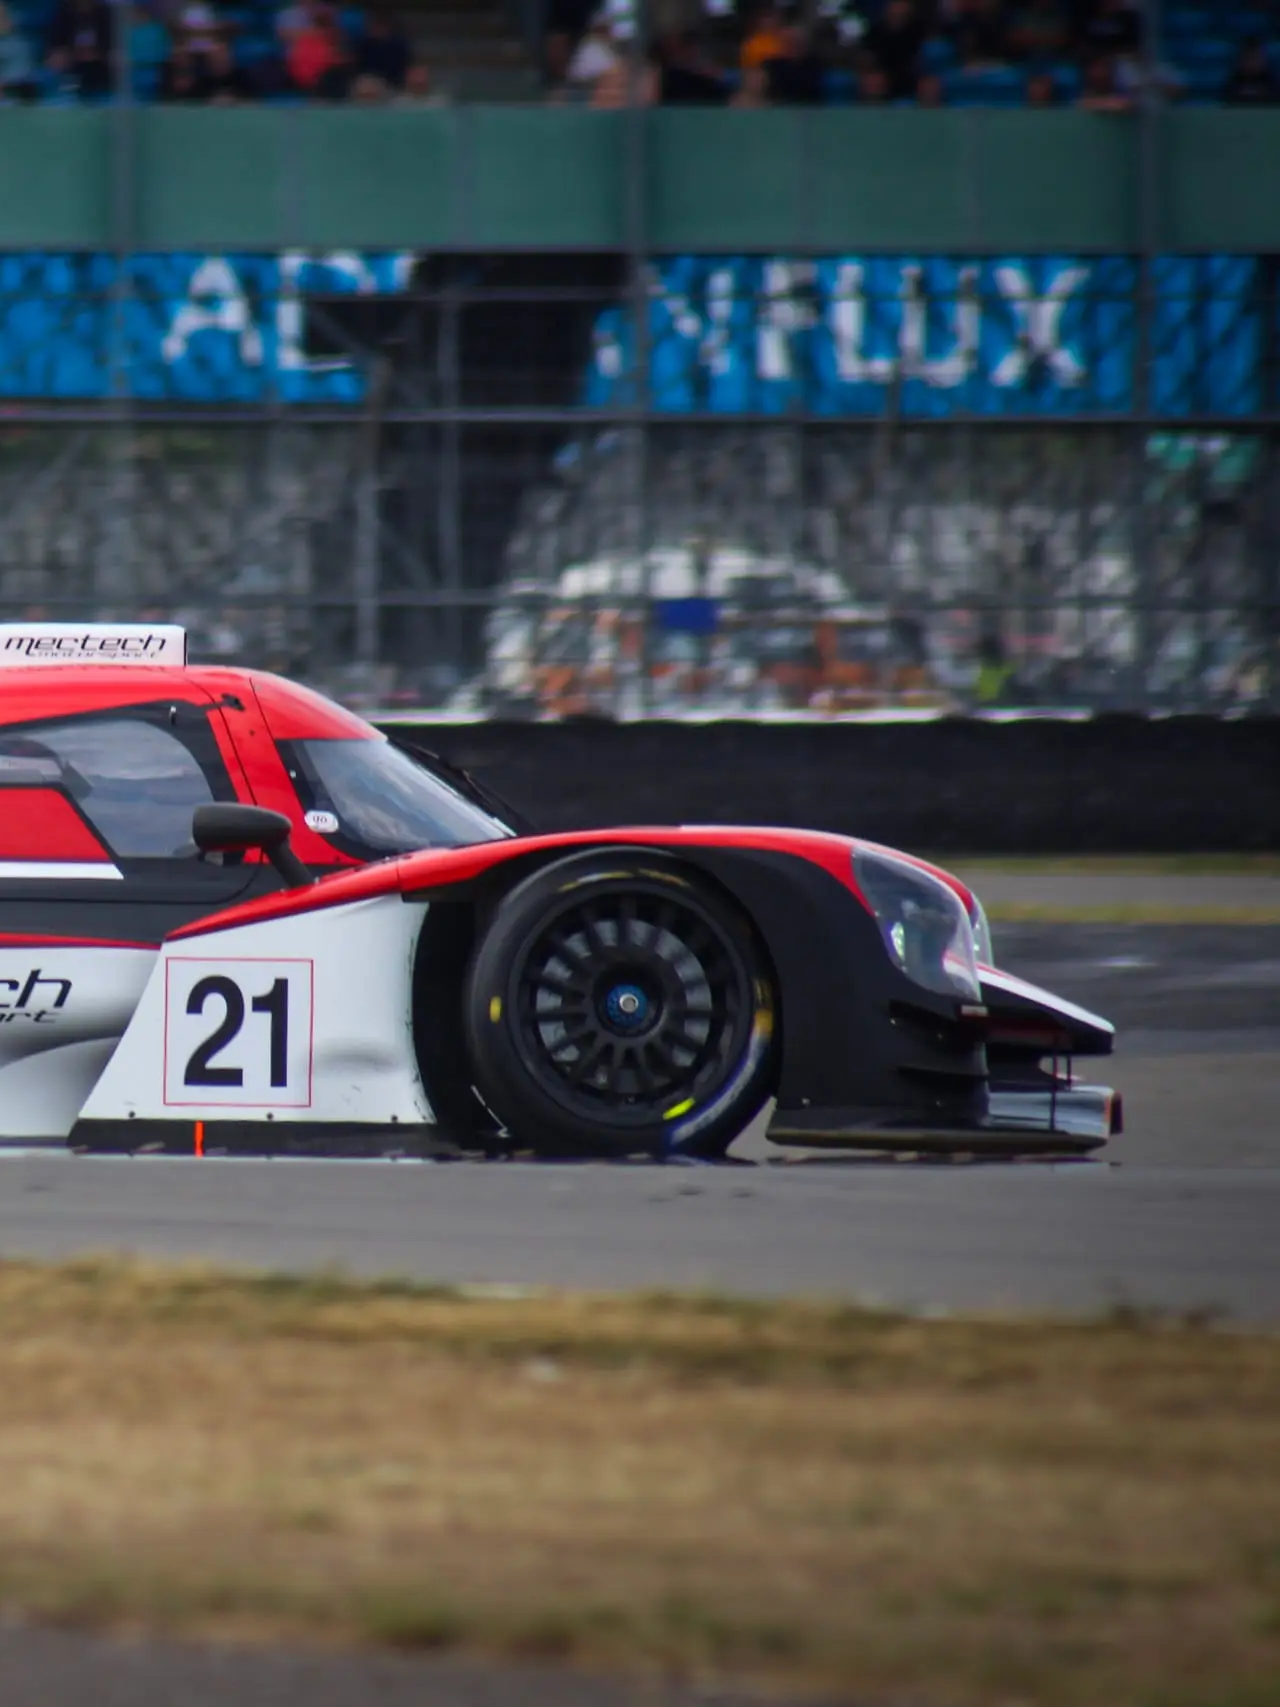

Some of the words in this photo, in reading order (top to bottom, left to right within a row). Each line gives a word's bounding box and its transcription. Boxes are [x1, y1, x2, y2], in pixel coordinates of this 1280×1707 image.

[758, 260, 1089, 388] FLUX
[4, 633, 167, 658] mectech
[183, 974, 289, 1088] 21
